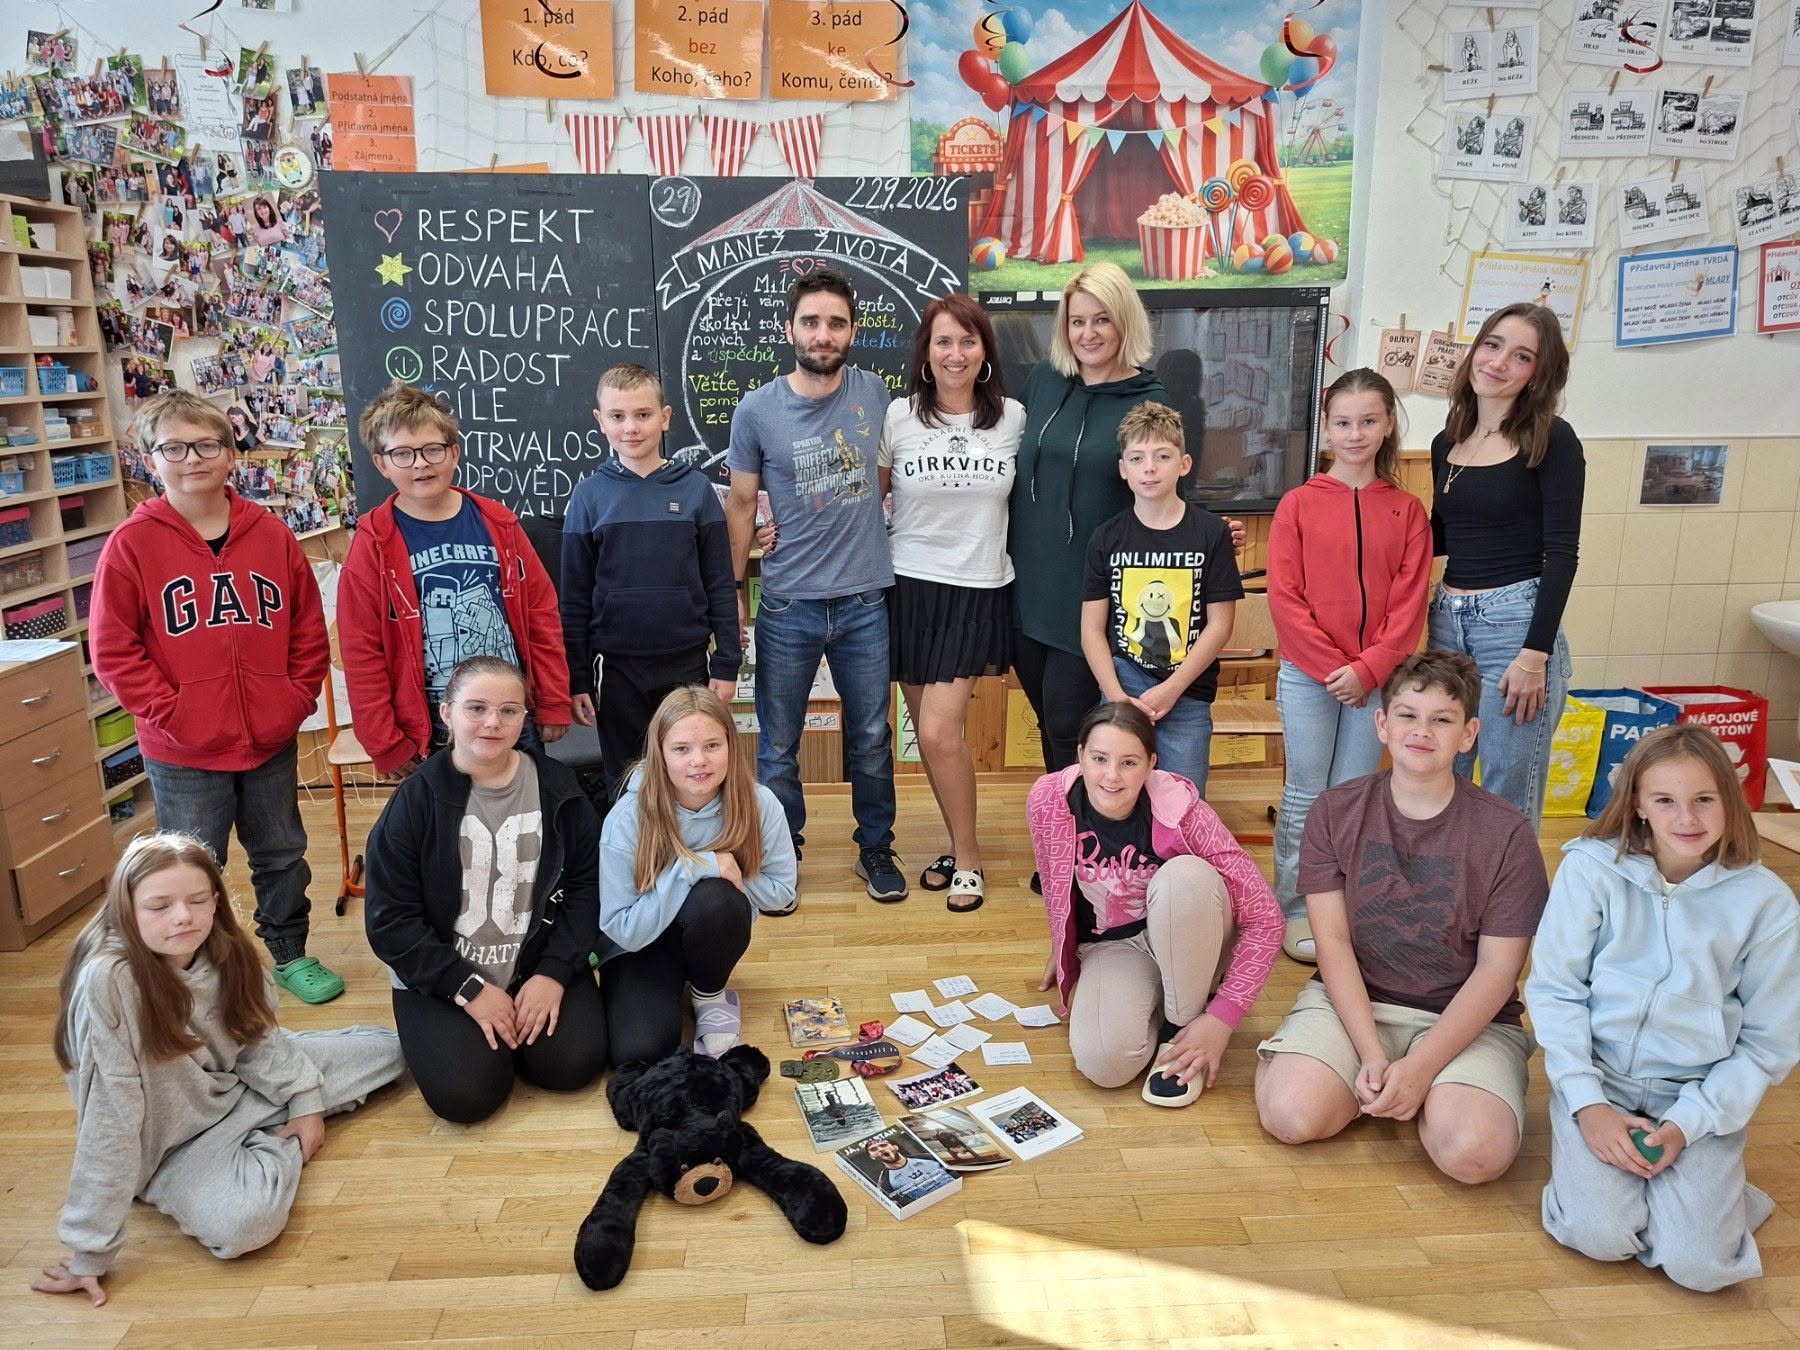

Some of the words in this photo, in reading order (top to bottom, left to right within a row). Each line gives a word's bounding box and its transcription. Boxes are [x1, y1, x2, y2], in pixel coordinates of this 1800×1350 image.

[524, 10, 539, 24] 1.
[544, 8, 574, 27] pád
[678, 7, 693, 22] 2.
[699, 7, 729, 26] pád
[812, 10, 827, 25] 3.
[832, 9, 862, 28] pád
[689, 39, 717, 55] bez
[828, 42, 846, 57] ke
[366, 79, 374, 88] 1.
[652, 66, 699, 85] Koho,
[703, 67, 752, 89] čeho?
[782, 72, 833, 90] Komu,
[332, 91, 378, 102] Podstatná
[380, 93, 408, 104] jména
[368, 109, 377, 118] 2.
[338, 121, 378, 132] Přídavná
[380, 122, 408, 133] jména
[369, 139, 377, 147] 3.
[950, 144, 996, 154] TICKETS
[355, 151, 393, 161] Zájmena
[658, 186, 694, 213] 29
[418, 208, 594, 244] RESPEKT
[814, 228, 909, 275] ŽIVOTA
[1630, 263, 1671, 273] Přídavná
[1672, 260, 1699, 270] jména
[1703, 255, 1729, 265] TVRDÁ
[418, 251, 572, 297] ODVAHA
[1705, 275, 1731, 285] MLADÝ
[707, 291, 748, 319] přeji
[424, 285, 650, 350] SPOLUPRÁCE
[699, 311, 750, 332] školní
[692, 332, 745, 347] nových
[1389, 335, 1415, 344] OBJEVY
[691, 350, 702, 361] a
[432, 345, 571, 387] RADOST
[706, 412, 729, 424] ze
[792, 436, 822, 450] SPARTAN
[793, 446, 840, 470] TRIFECTA
[904, 455, 1007, 477] CÍRKVICE
[795, 463, 828, 482] WORLD
[796, 467, 866, 496] CHAMPIONSHIP
[972, 474, 995, 482] HORA
[409, 543, 499, 571] INECRAFT
[1110, 552, 1205, 567] UNLIMITED
[161, 570, 284, 638] GAP
[1688, 709, 1758, 725] NÁPOJOVÉ
